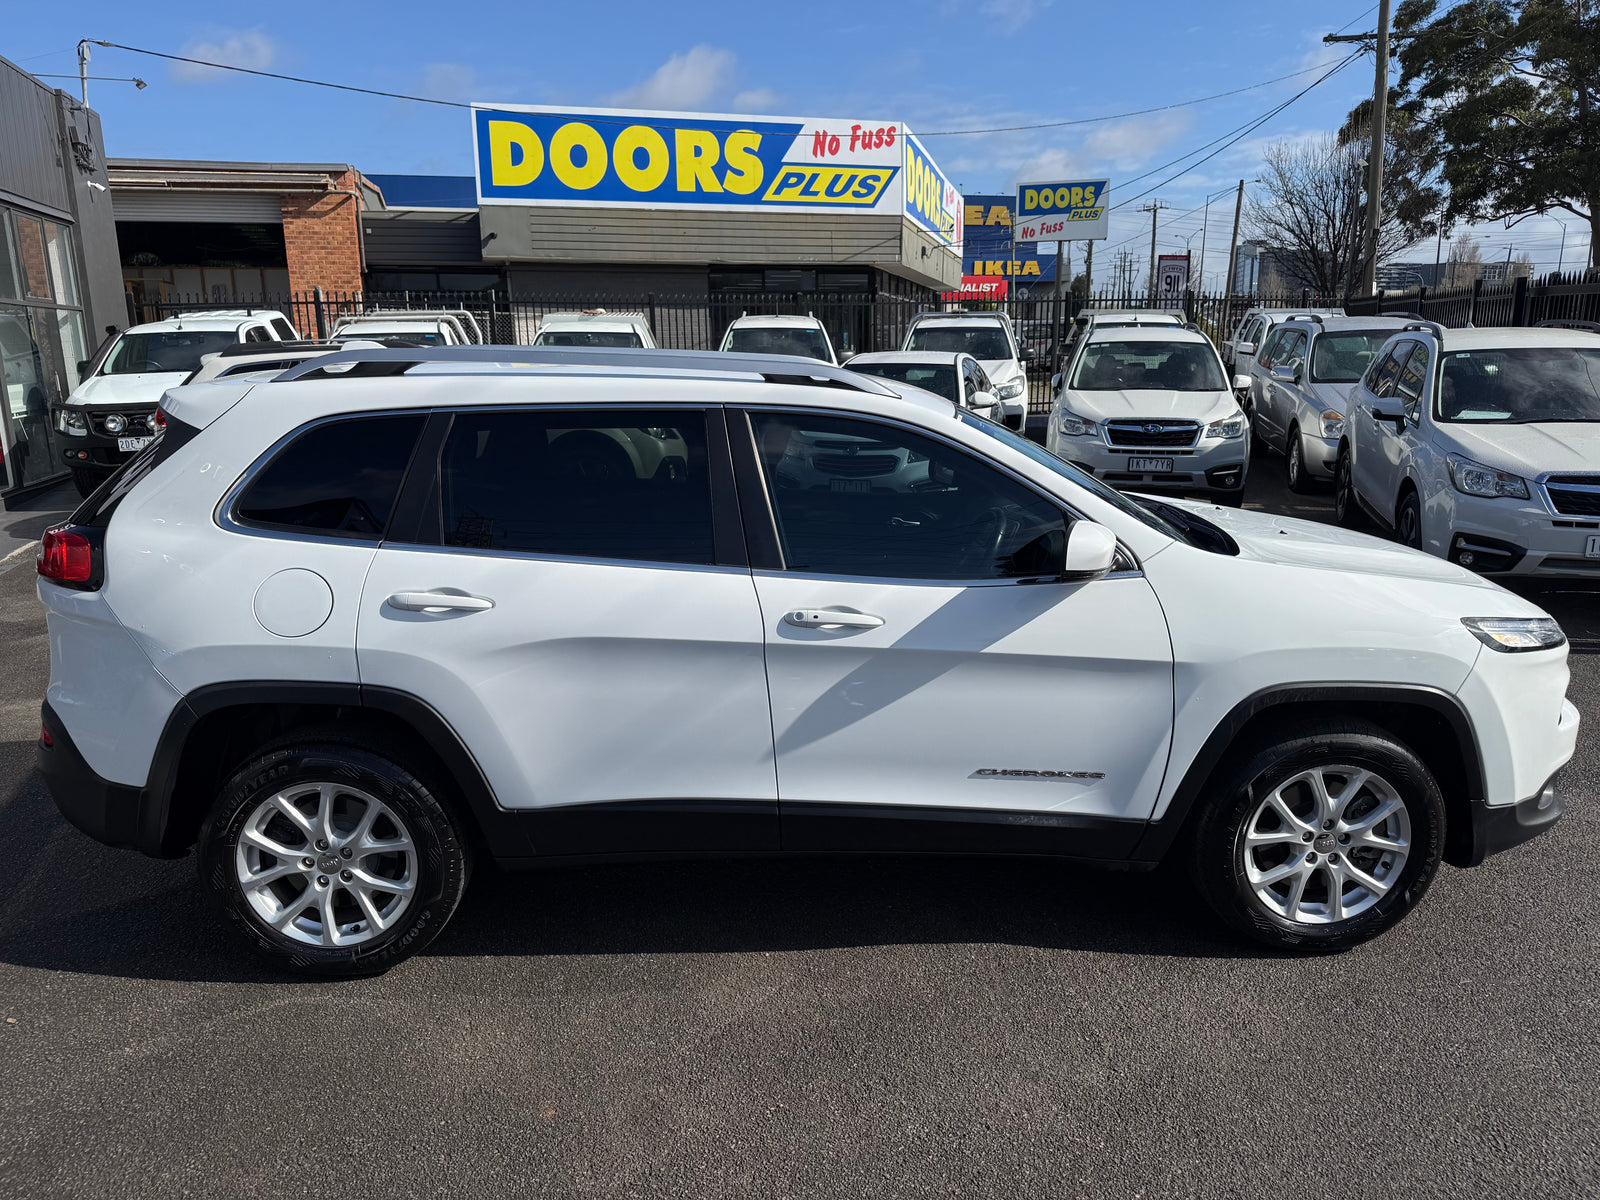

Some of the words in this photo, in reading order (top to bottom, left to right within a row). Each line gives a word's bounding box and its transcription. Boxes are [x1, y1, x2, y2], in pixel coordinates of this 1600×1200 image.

[812, 129, 841, 159] No
[849, 123, 897, 154] Fuss
[488, 120, 764, 196] DOORS
[775, 171, 882, 199] PLUS
[906, 143, 941, 229] DOORS
[1024, 186, 1096, 210] DOORS
[964, 205, 1013, 226] EA
[1071, 209, 1099, 219] PLUS
[1021, 226, 1036, 240] No
[1039, 221, 1065, 236] Fuss
[973, 260, 1041, 276] IKEA
[960, 282, 999, 292] IALIST
[1164, 274, 1180, 293] 911
[976, 768, 1106, 779] CHEROKEE
